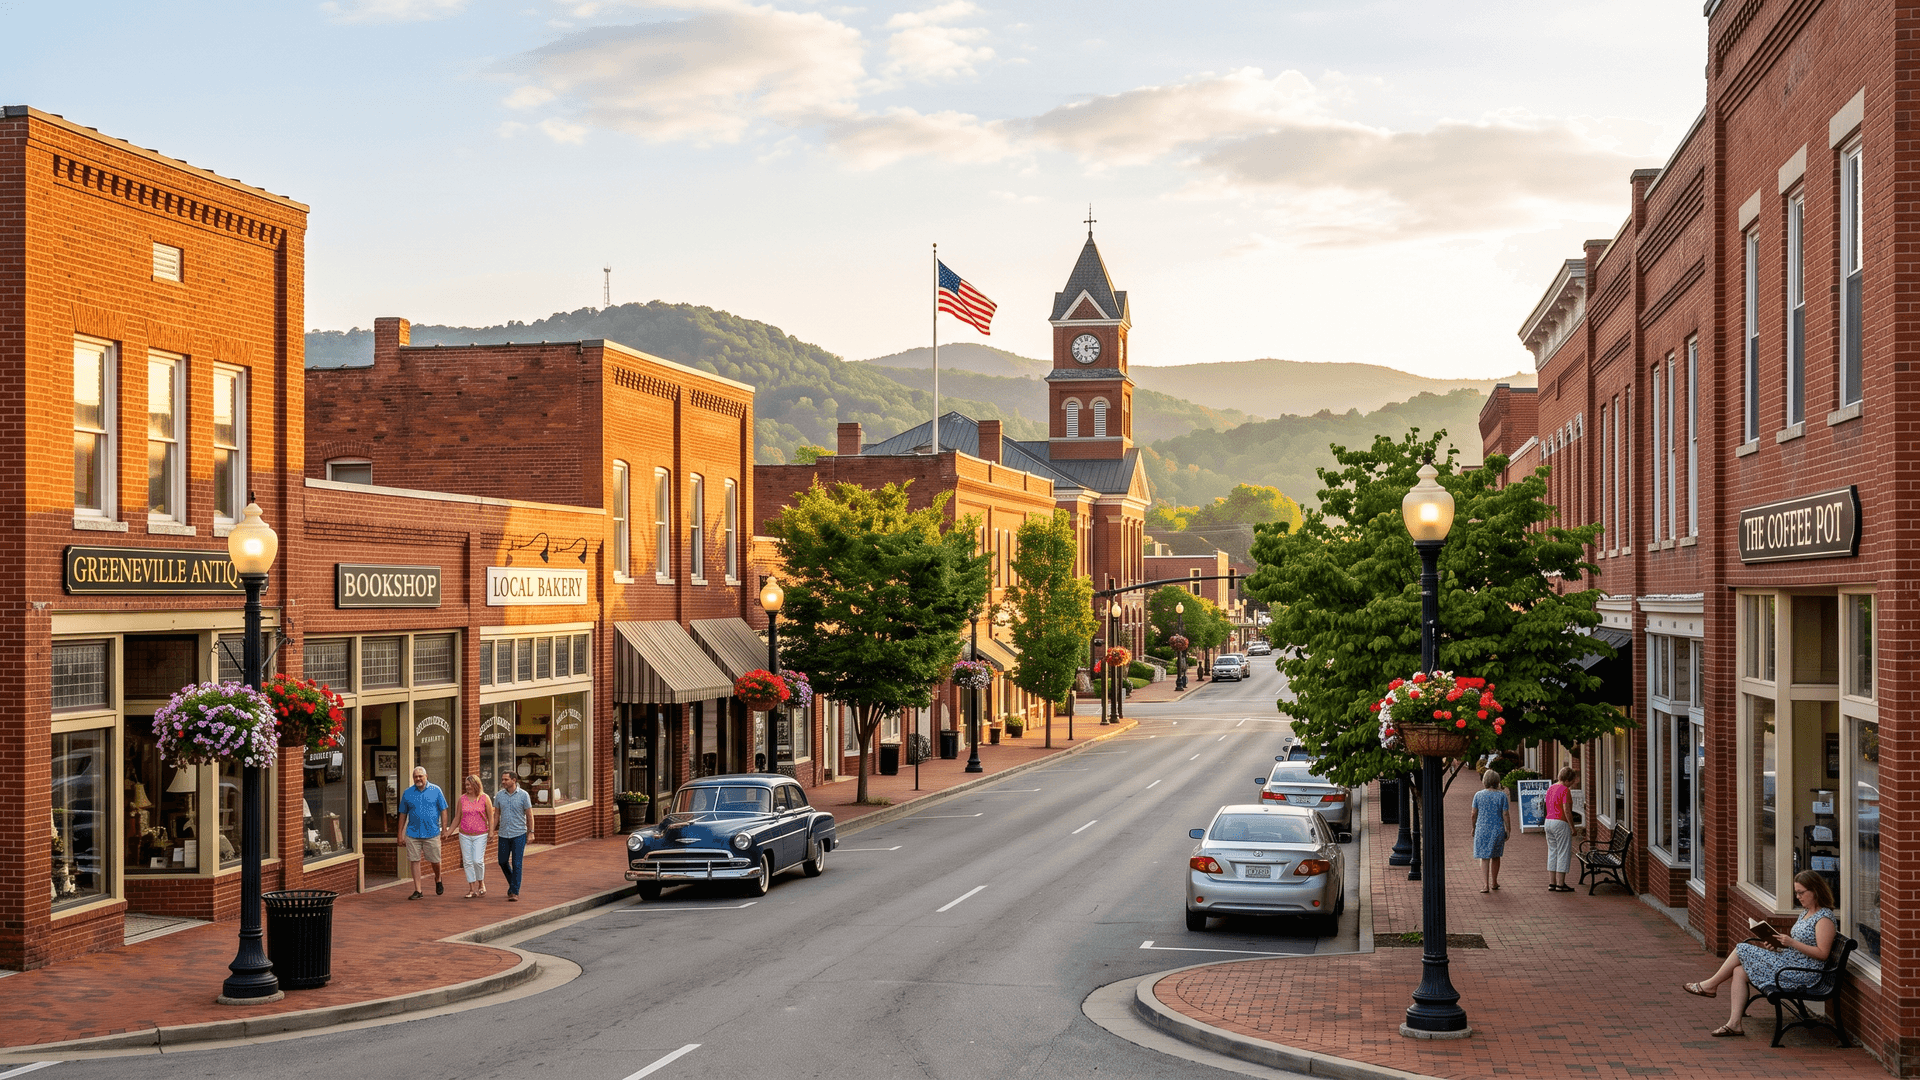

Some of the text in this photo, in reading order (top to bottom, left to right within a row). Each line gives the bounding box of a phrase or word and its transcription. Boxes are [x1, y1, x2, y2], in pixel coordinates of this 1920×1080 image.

[1745, 502, 1843, 551] THE COFFEE POT
[73, 556, 243, 588] GREENEVILLE ANTIQ
[344, 573, 437, 597] BOOKSHOP
[493, 576, 582, 597] LOCAL BAKERY
